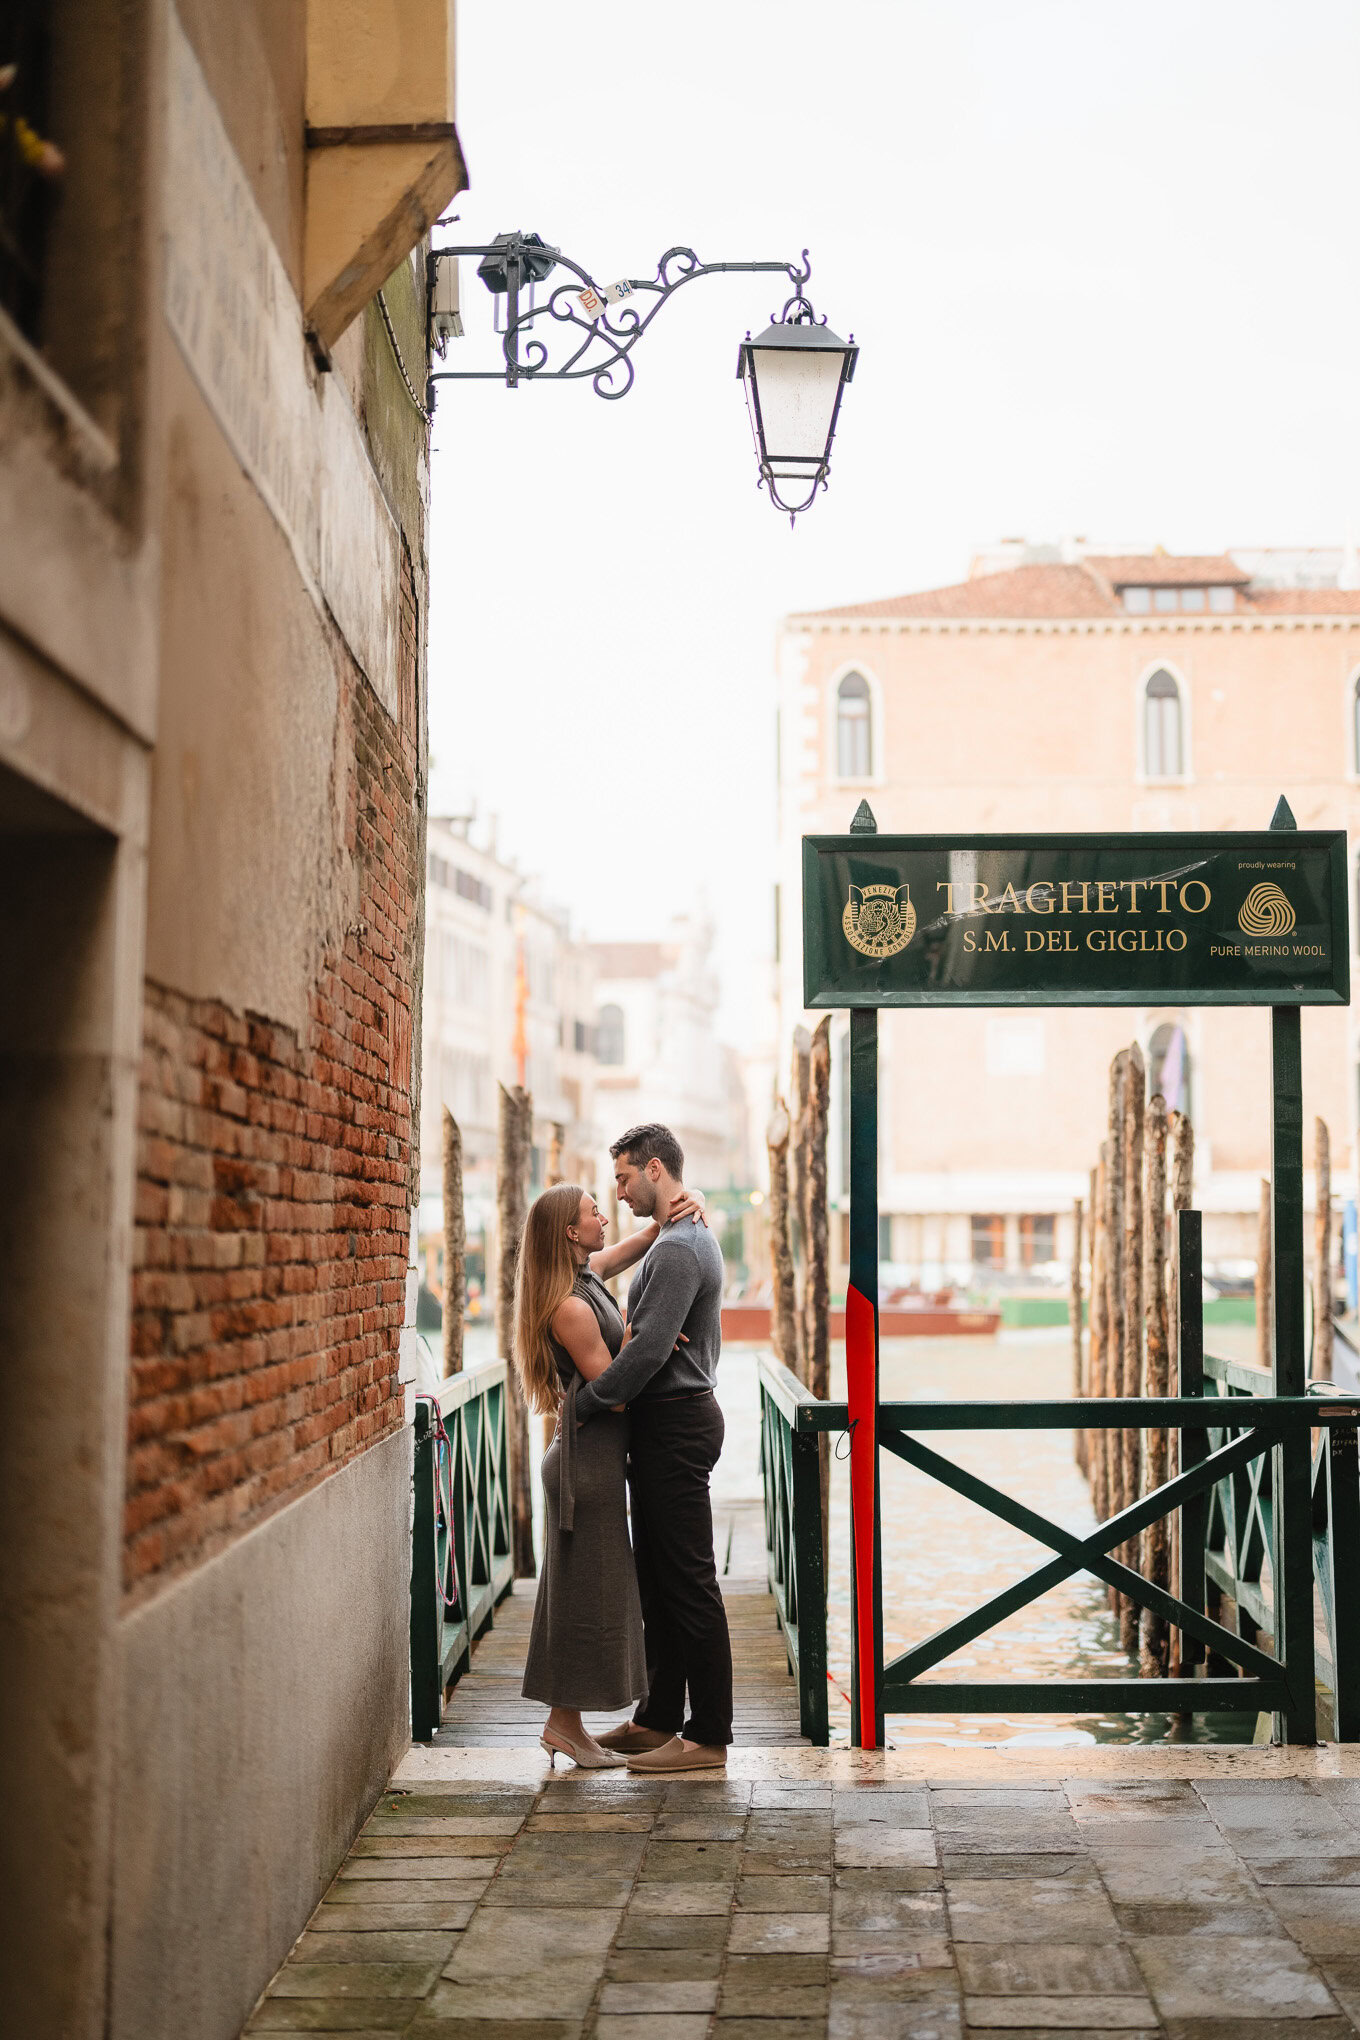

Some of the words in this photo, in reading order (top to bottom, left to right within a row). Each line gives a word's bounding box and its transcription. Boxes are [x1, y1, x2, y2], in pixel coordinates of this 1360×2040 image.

[1238, 861, 1265, 870] proudly
[1267, 862, 1296, 871] wearing
[863, 886, 895, 896] VENEZIA
[936, 880, 1212, 914] TRAGHETTO
[845, 915, 884, 956] ASSOCIAZIONE
[963, 930, 1015, 953] S.M.
[1025, 930, 1078, 952] DEL
[1086, 930, 1188, 952] GIGLIO
[1210, 945, 1241, 956] PURE
[1245, 945, 1289, 956] MERINO
[1292, 945, 1326, 956] WOOL
